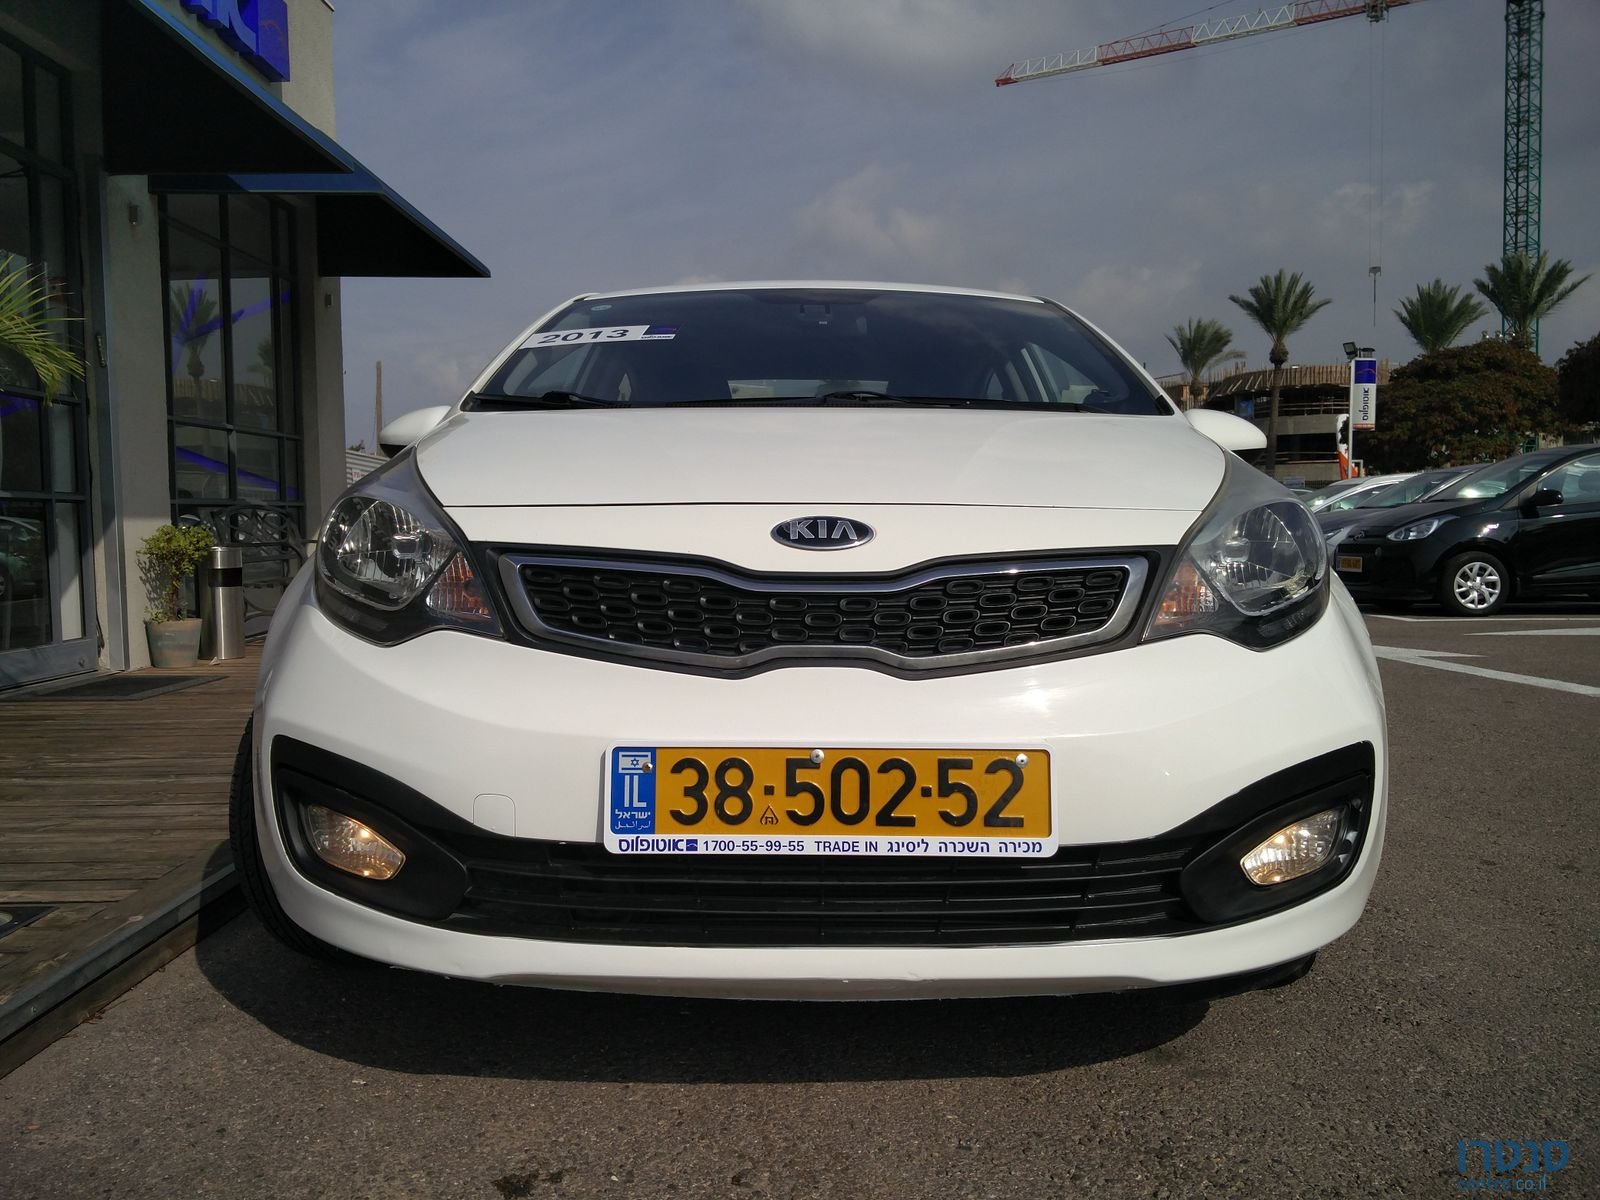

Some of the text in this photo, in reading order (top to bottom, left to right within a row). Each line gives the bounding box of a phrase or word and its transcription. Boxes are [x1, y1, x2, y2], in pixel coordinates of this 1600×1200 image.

[538, 329, 630, 345] 2013
[789, 519, 858, 540] KIA
[624, 775, 647, 807] IL
[615, 808, 651, 819] ישראל
[618, 836, 685, 852] אוטופלוס
[814, 840, 878, 853] TRADE IN
[887, 838, 1043, 854] מכירה השכרה ליסינג
